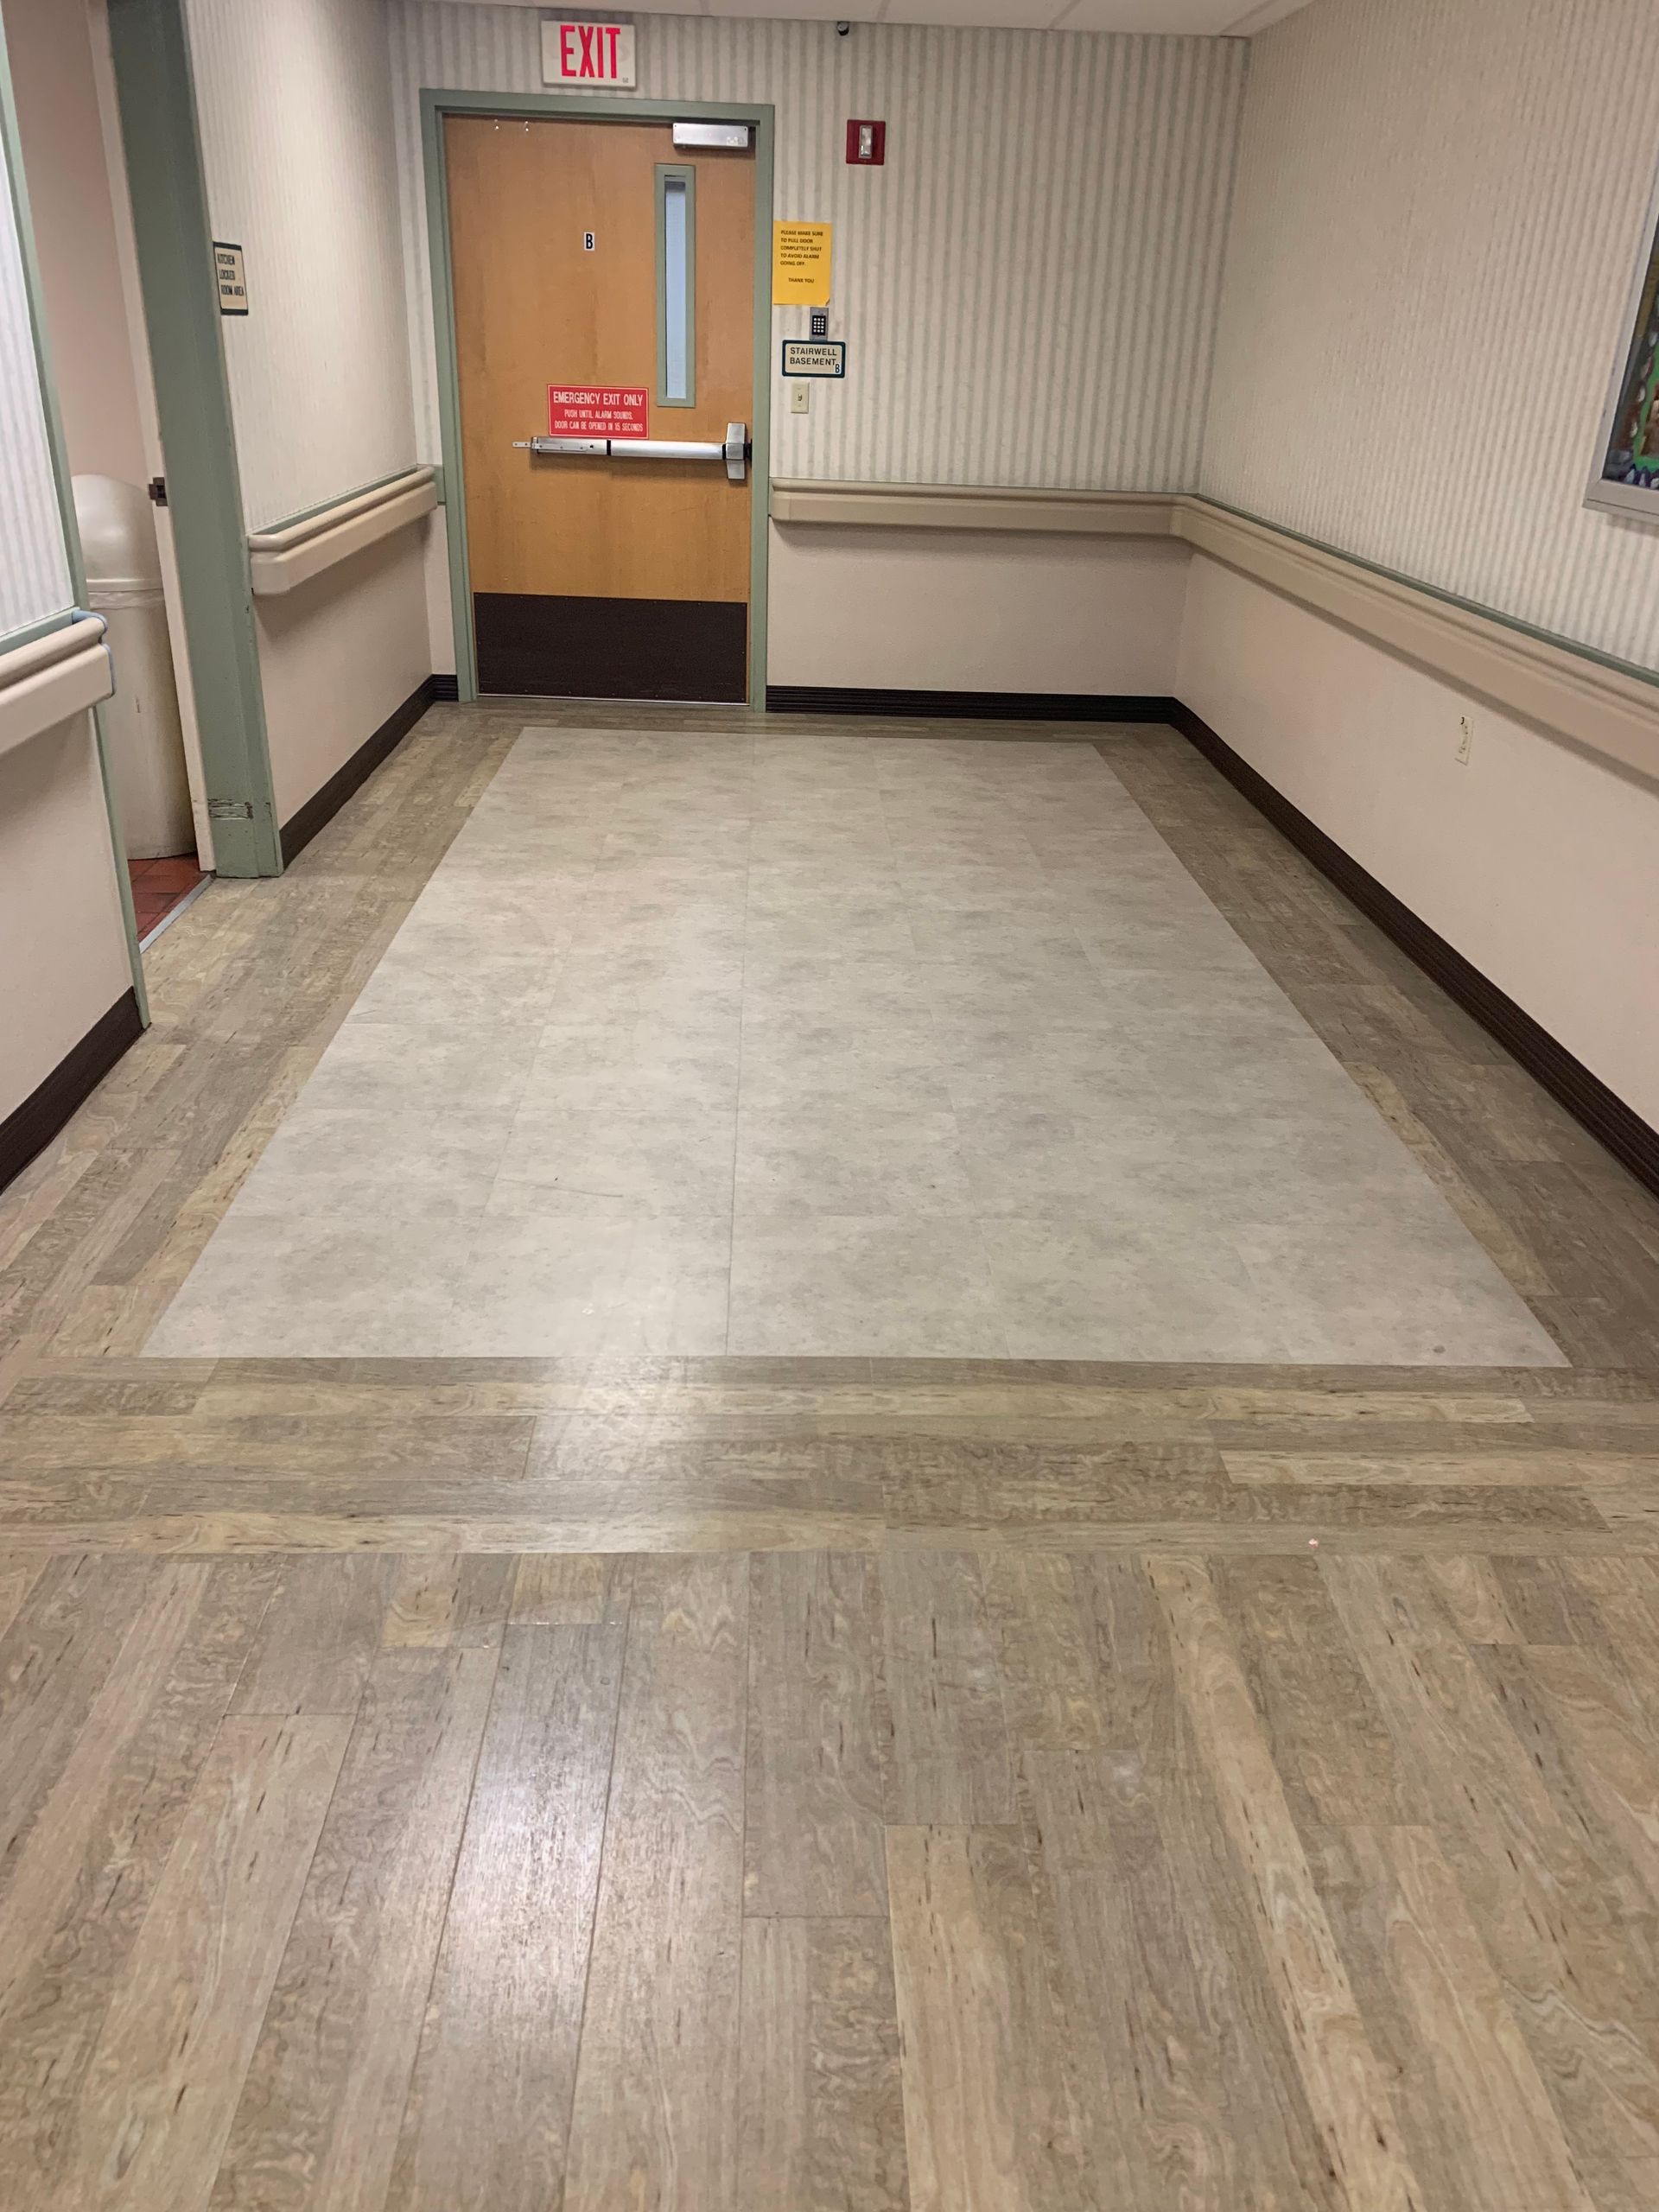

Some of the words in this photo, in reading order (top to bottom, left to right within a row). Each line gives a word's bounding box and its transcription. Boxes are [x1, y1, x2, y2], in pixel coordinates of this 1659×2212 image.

[560, 25, 620, 79] EXIT
[586, 233, 593, 249] B
[790, 346, 837, 356] STAIRWELL
[790, 357, 836, 366] BASEMENT
[836, 364, 840, 373] B
[553, 391, 601, 404] EMERGENCY
[603, 393, 620, 405] EXIT
[624, 394, 643, 406] ONLY
[564, 409, 577, 418] PUSH
[579, 410, 594, 419] UNTIL
[595, 410, 612, 419] ALARM
[569, 421, 580, 429] CAN
[581, 422, 587, 430] BE
[588, 422, 607, 430] OPENED
[622, 423, 643, 432] SECONDS
